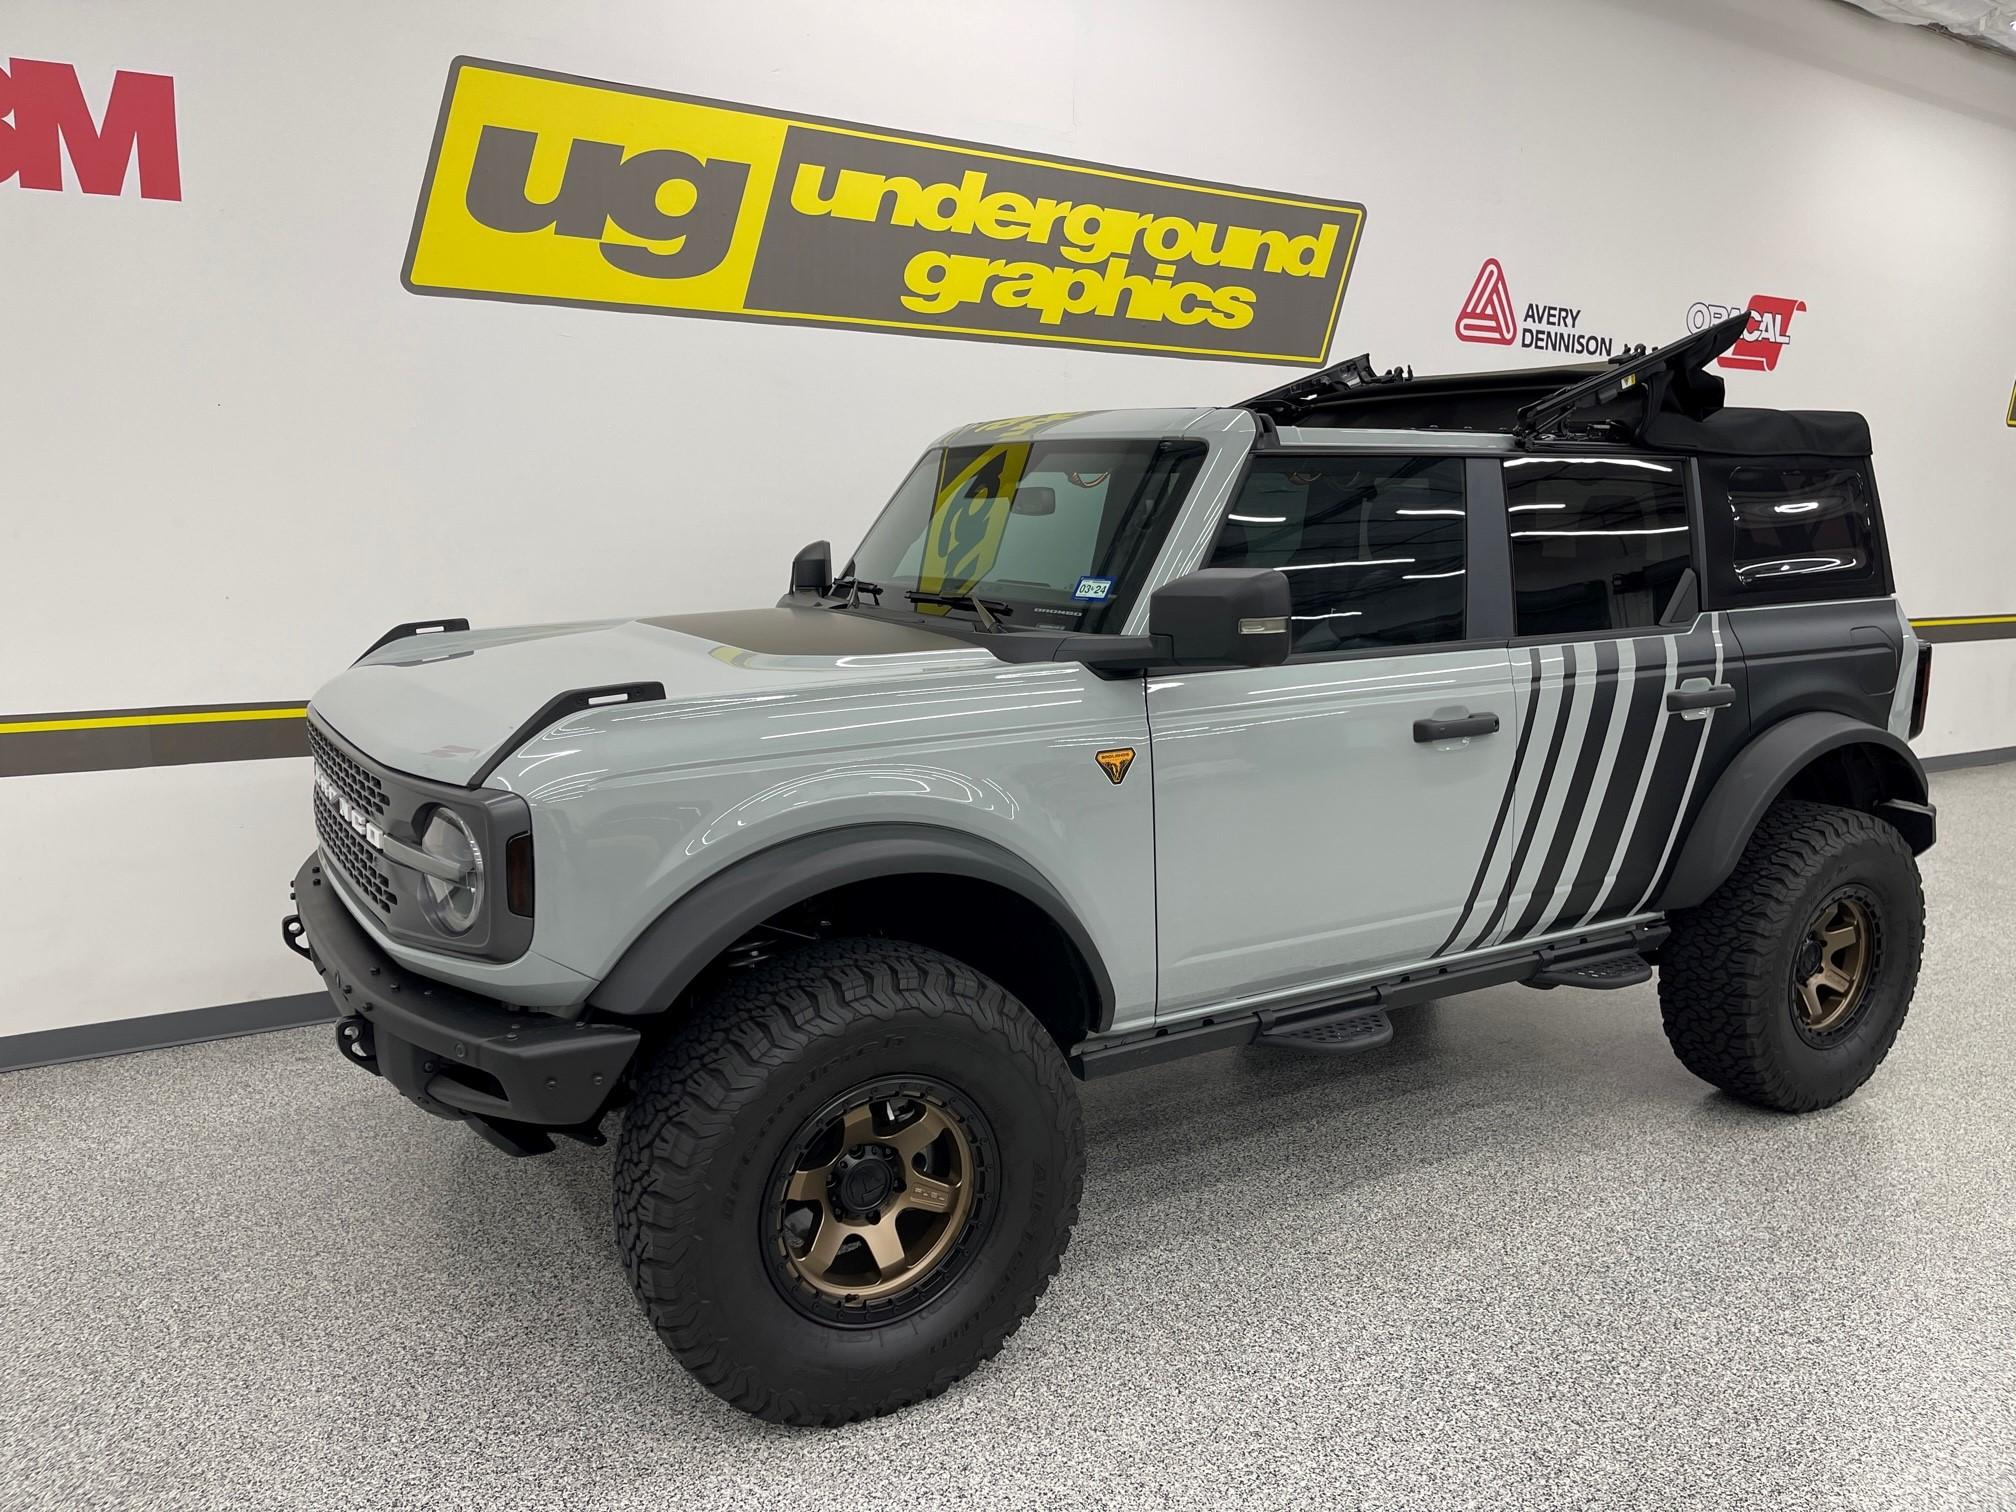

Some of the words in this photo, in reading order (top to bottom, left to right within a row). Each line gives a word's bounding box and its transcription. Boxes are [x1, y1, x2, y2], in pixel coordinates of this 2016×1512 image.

[0, 57, 182, 201] M
[466, 124, 752, 279] ug
[790, 163, 1340, 278] underground
[901, 251, 1257, 329] graphics
[1523, 303, 1582, 328] AVERY
[1521, 327, 1613, 357] DENNISON
